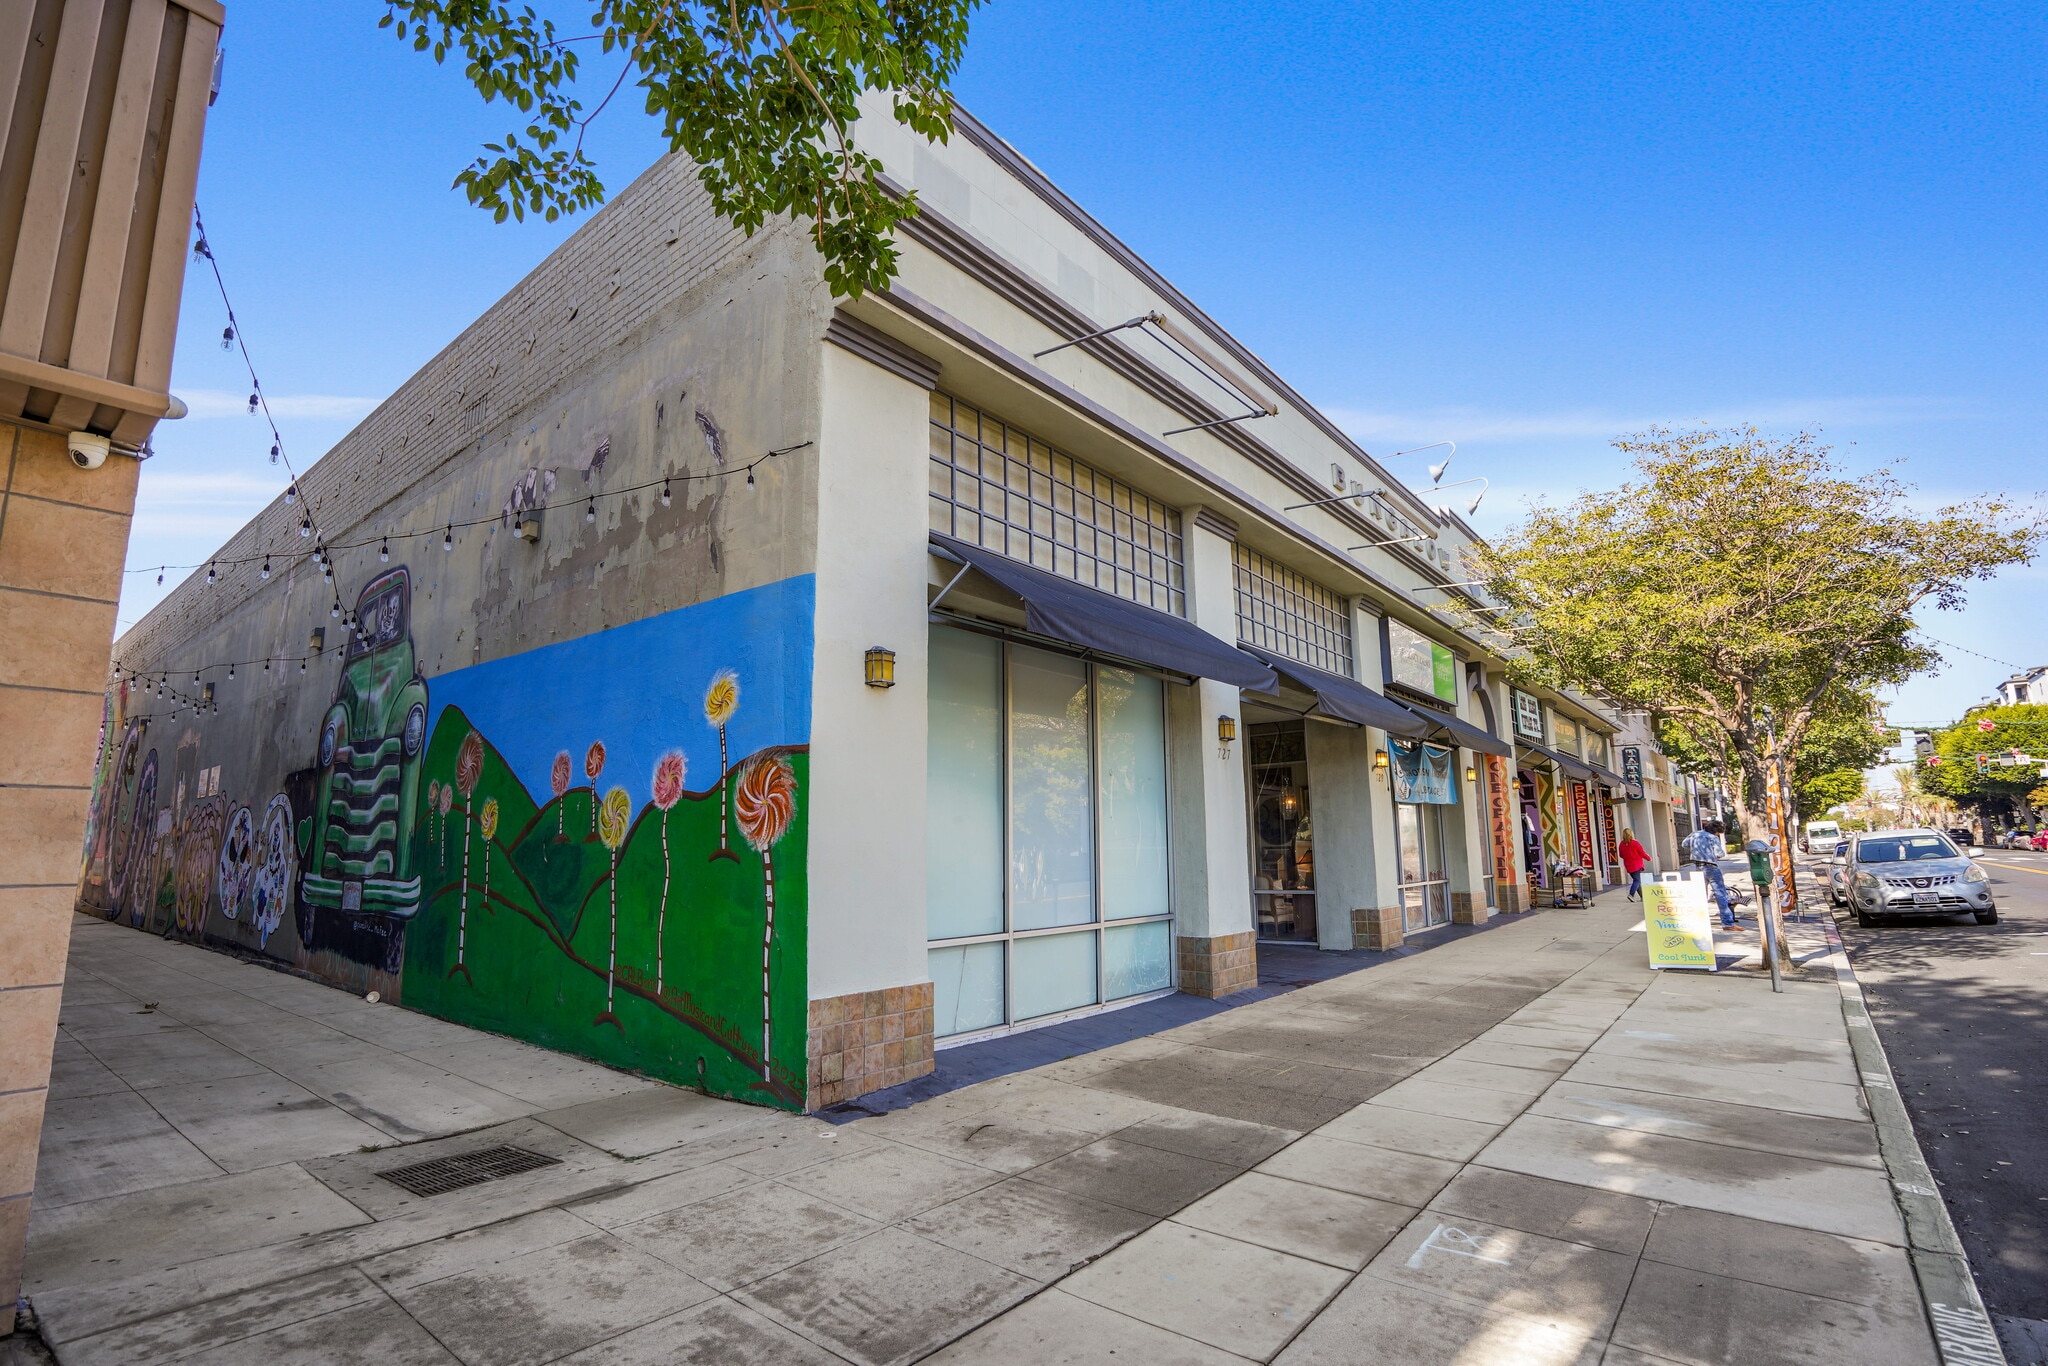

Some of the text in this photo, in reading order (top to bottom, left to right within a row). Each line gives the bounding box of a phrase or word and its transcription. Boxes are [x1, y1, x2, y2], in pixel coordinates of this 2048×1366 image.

[1331, 463, 1450, 571] BUNGALOW
[1217, 747, 1231, 760] 727
[1625, 749, 1643, 799] TATTO
[1574, 785, 1592, 868] PROFESSIONAL
[1603, 796, 1618, 863] MODERN
[1767, 769, 1792, 908] NTIQUES
[1658, 953, 1706, 962] Cool Junk
[773, 1057, 805, 1092] 2022
[1931, 1302, 2004, 1366] ARKING
